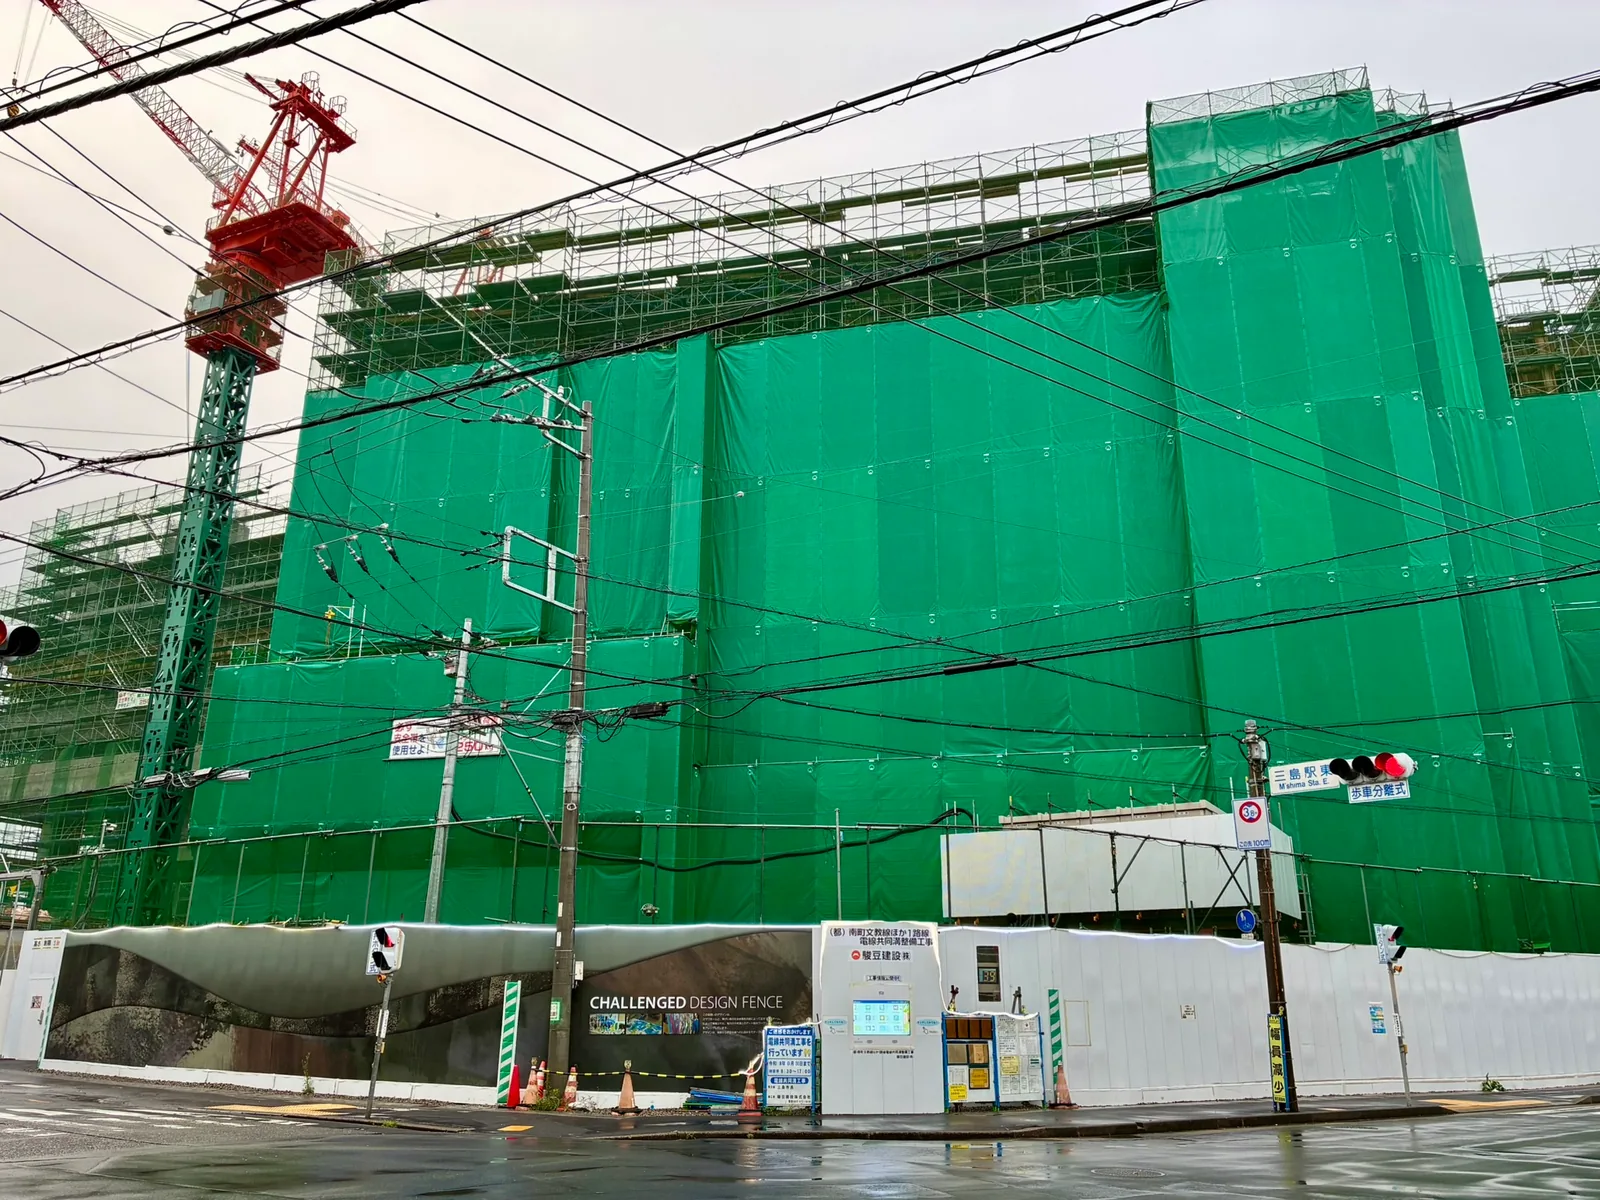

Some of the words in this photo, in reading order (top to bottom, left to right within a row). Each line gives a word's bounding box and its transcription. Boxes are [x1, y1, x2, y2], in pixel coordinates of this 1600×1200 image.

[1351, 783, 1407, 800] 歩車分離式
[589, 996, 687, 1010] CHALLENGED
[689, 995, 738, 1010] DESIGN
[742, 995, 783, 1009] FENCE
[768, 1048, 803, 1057] 行っています
[1270, 1027, 1284, 1094] 幅員減少
